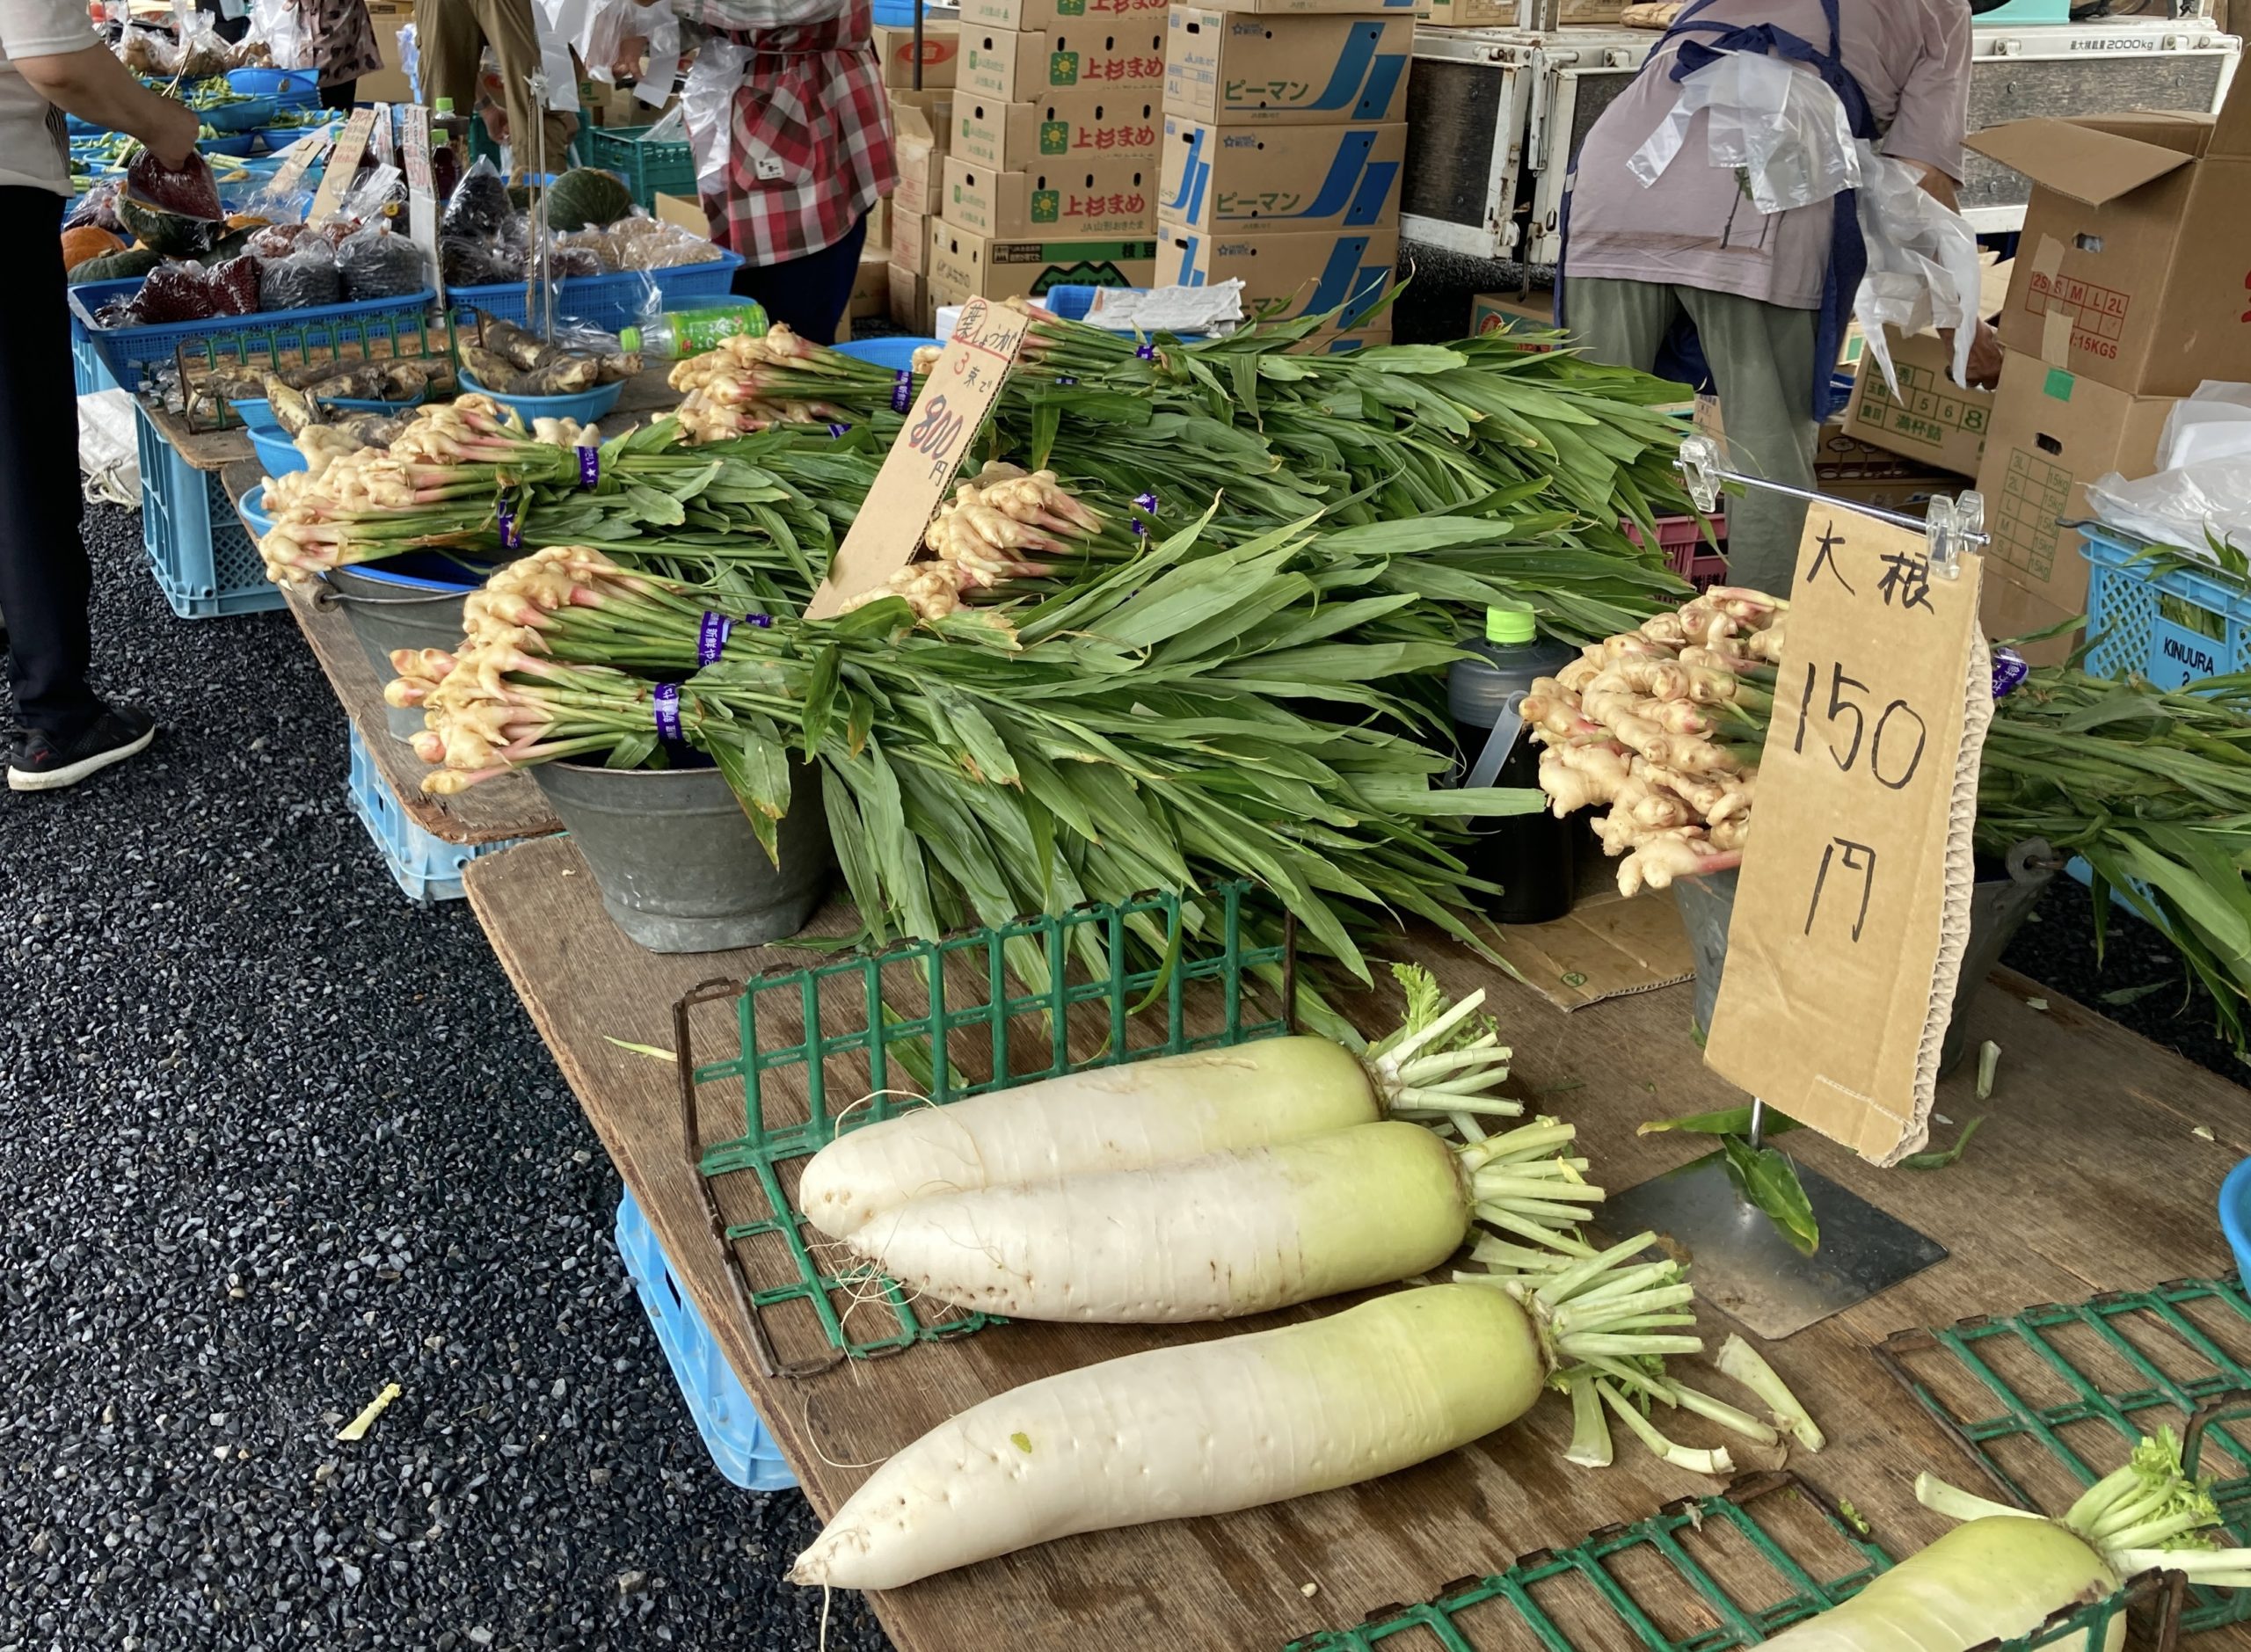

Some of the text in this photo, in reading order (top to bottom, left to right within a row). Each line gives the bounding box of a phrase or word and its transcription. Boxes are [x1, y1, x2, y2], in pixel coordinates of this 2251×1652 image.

[1082, 56, 1164, 81] 上杉まめ
[1225, 79, 1309, 102] ピーマン
[1072, 125, 1155, 149] 上杉まめ
[1062, 193, 1146, 218] 上杉まめ
[1217, 191, 1300, 213] ピーマン
[2033, 273, 2049, 289] 2S
[2053, 280, 2063, 295] S
[2070, 285, 2084, 302] M
[2093, 292, 2101, 308] L
[2107, 297, 2124, 315] 2L
[1920, 398, 1929, 411] 5
[1944, 404, 1954, 419] 6
[908, 394, 964, 461] 800
[1964, 410, 1983, 430] 8
[929, 459, 949, 487] 円
[2050, 472, 2070, 493] 15kg
[2044, 493, 2065, 515] 15kg
[2035, 535, 2055, 559] 15kg
[1806, 520, 1934, 615] 大根
[2029, 557, 2051, 580] 15kg
[2163, 637, 2215, 676] KINUURA
[1793, 661, 1927, 790] 150
[1804, 836, 1876, 943] 円
